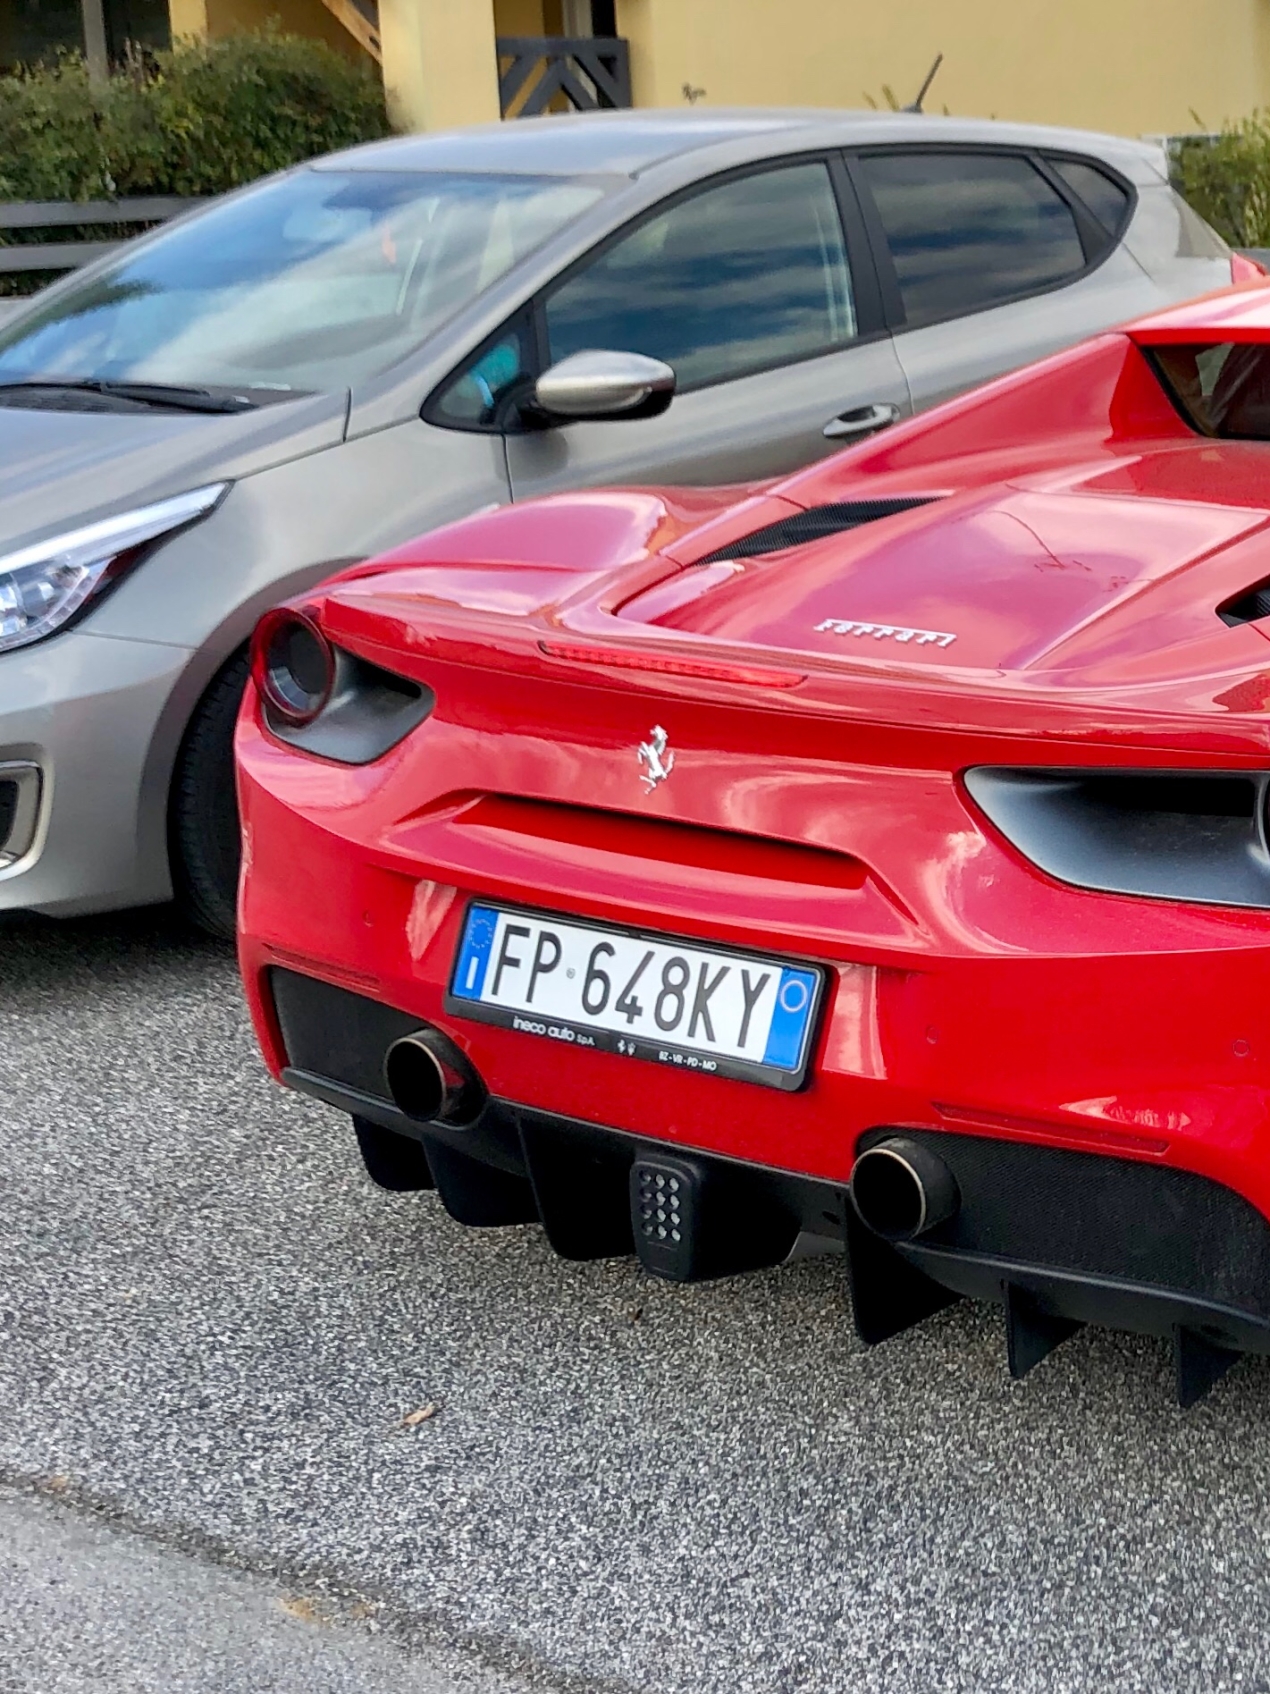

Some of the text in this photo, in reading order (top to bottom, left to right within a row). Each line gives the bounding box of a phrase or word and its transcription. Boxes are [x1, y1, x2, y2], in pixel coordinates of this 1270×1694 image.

[490, 923, 772, 1048] FP 648KY
[512, 1015, 547, 1036] ineco
[547, 1026, 576, 1041] auto
